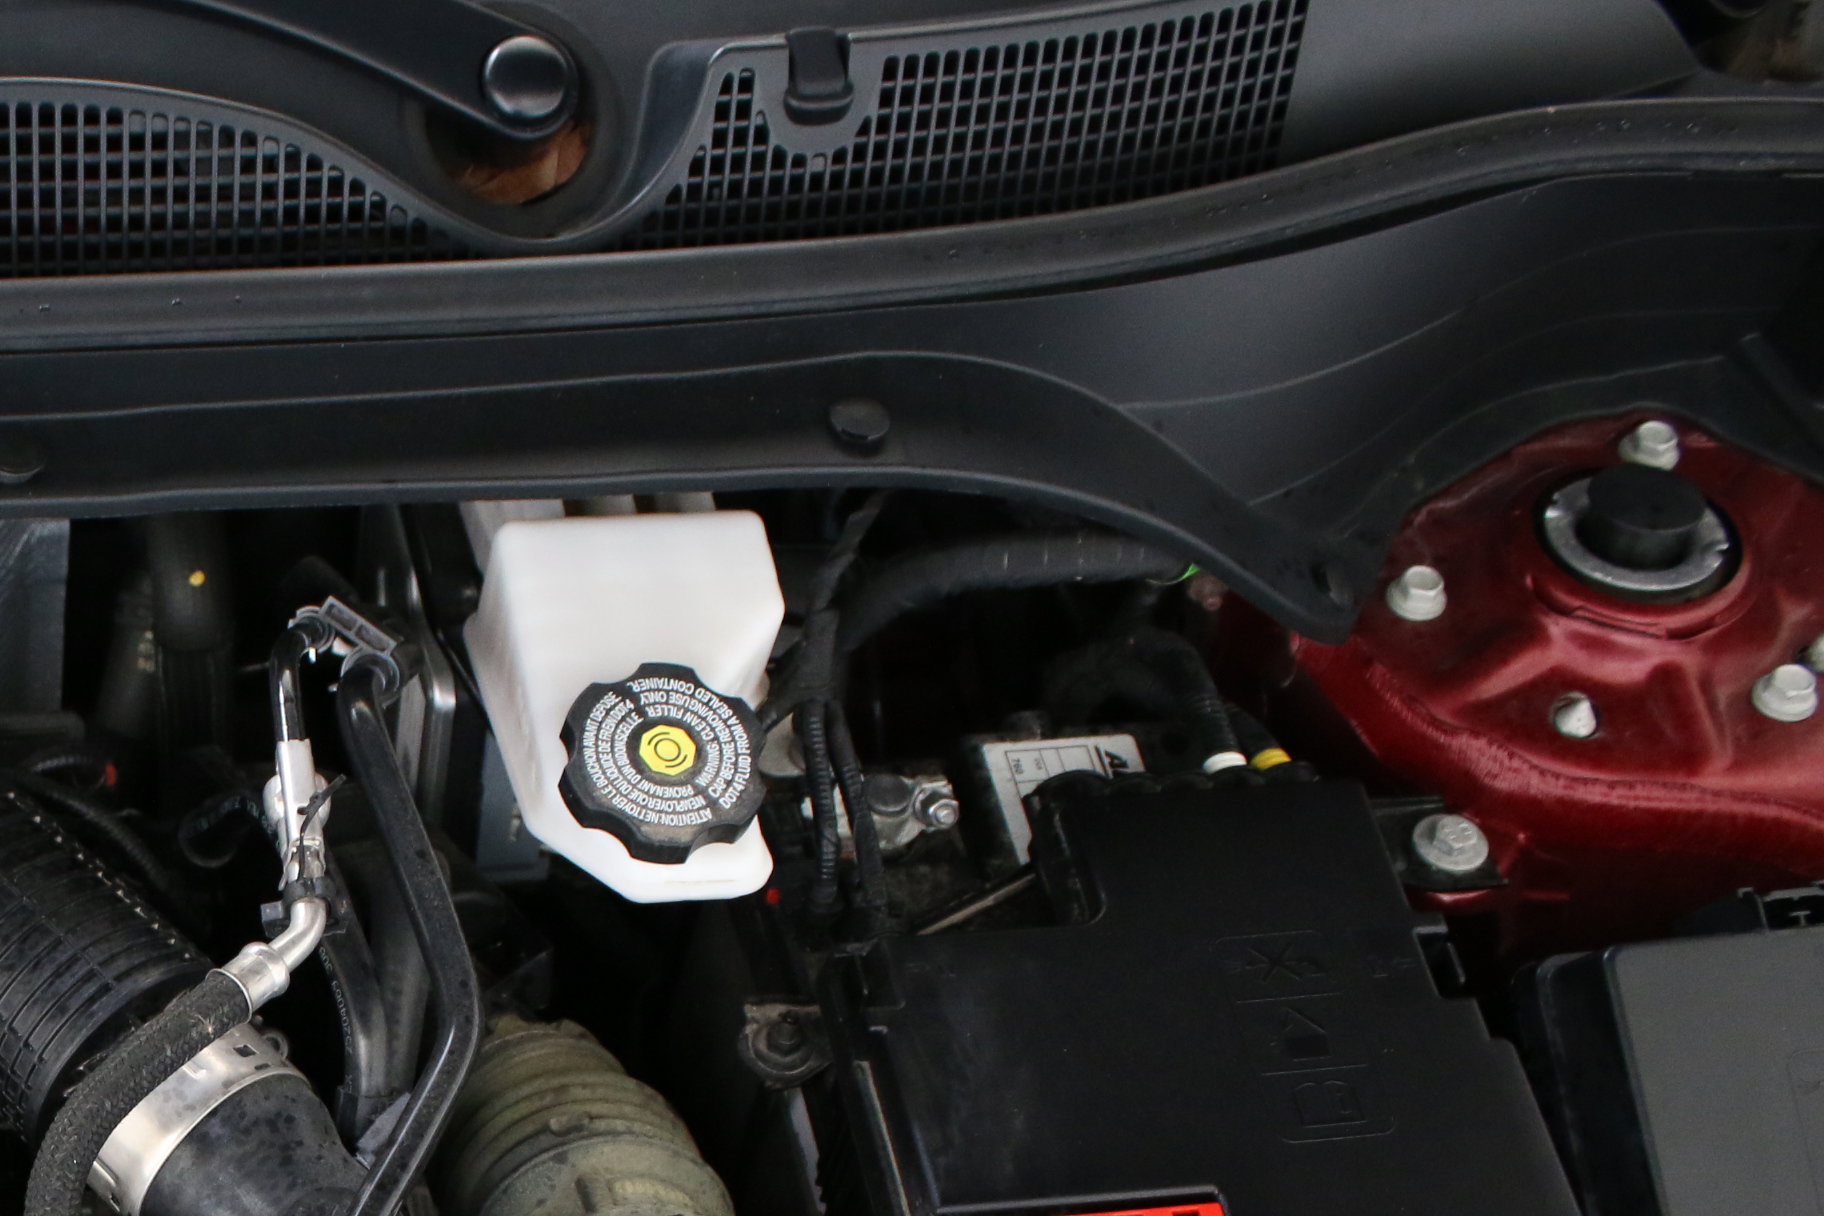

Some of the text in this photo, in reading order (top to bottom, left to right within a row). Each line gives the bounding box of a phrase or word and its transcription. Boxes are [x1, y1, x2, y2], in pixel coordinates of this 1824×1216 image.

[639, 691, 667, 706] ONLY
[668, 691, 691, 708] USE
[694, 688, 733, 720] SEALED
[645, 704, 685, 719] FILLER
[726, 715, 740, 725] A
[583, 718, 600, 748] AVANT
[682, 711, 715, 742] CLEAN
[598, 739, 611, 752] DE
[730, 724, 751, 754] FROM
[583, 747, 610, 789] BOUCHON
[717, 741, 736, 781] BEFORE
[733, 755, 752, 785] FLUID
[599, 784, 618, 800] LE
[614, 779, 634, 796] DU
[626, 788, 650, 806] QUE
[707, 775, 727, 799] CAP
[730, 781, 745, 792] 4
[609, 793, 660, 824] NETTOYER
[718, 787, 740, 810] DOT
